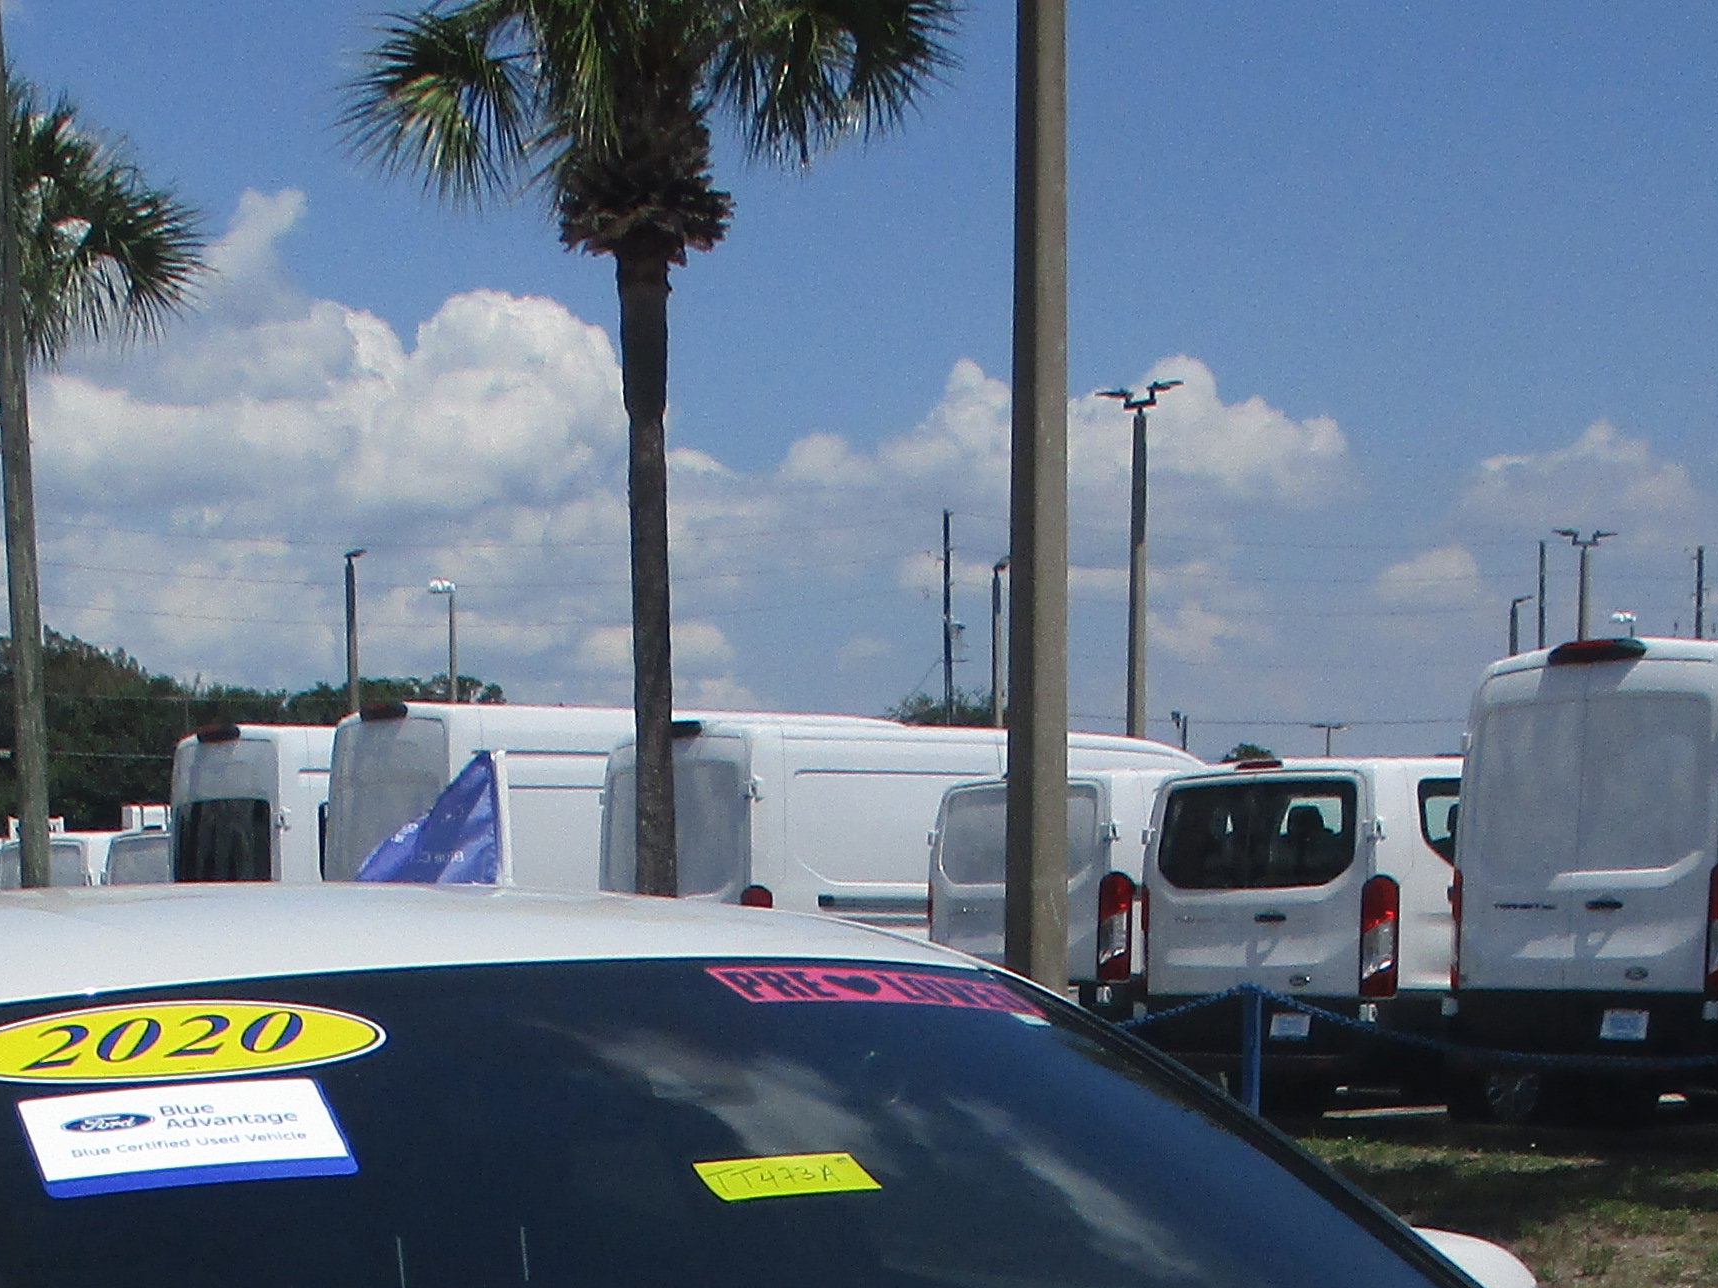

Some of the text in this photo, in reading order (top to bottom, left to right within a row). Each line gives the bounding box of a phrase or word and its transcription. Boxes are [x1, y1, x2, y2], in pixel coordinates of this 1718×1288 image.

[719, 970, 838, 999] PRE
[21, 1011, 303, 1071] 2020
[159, 1103, 215, 1117] Blue
[166, 1111, 298, 1130] Advantage
[71, 1131, 307, 1159] Blue Certified Used Vehicle
